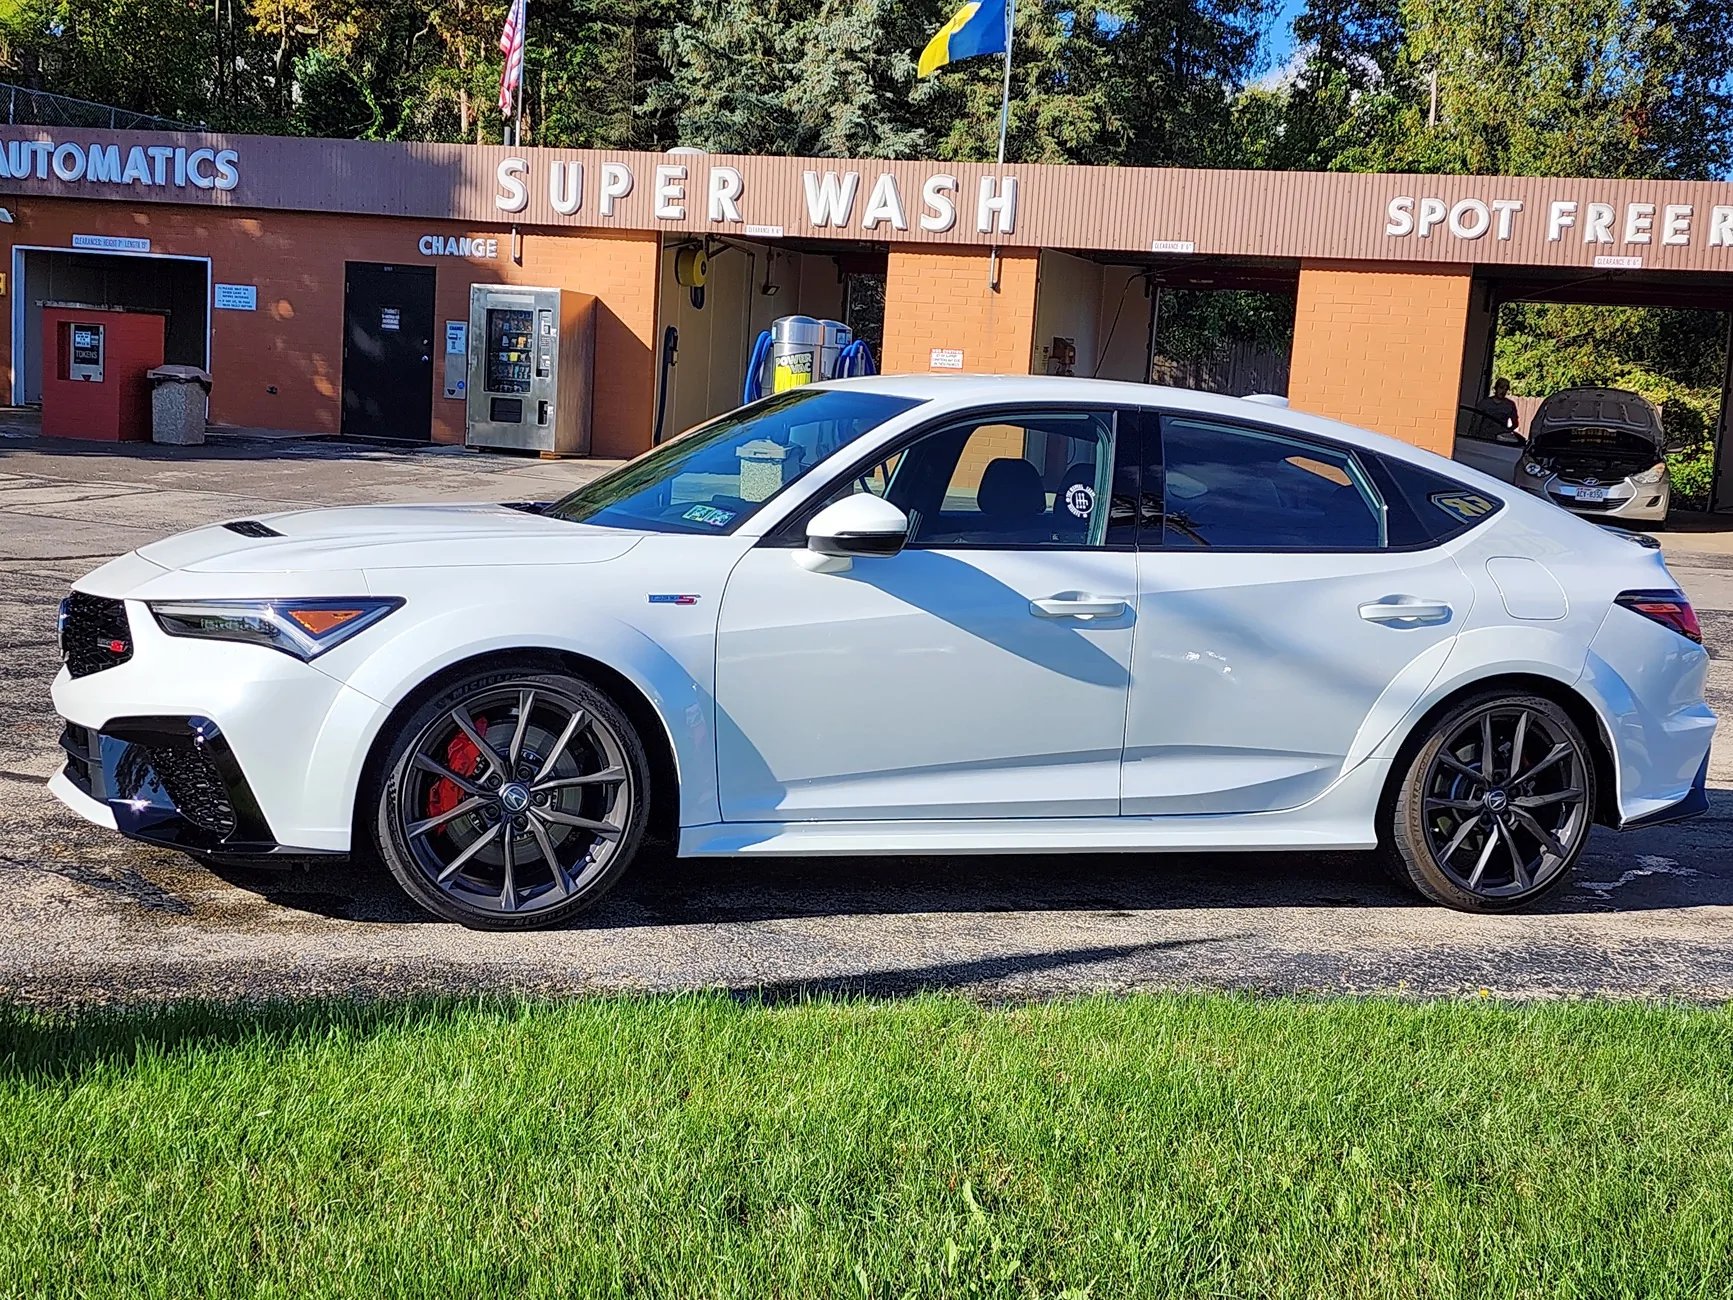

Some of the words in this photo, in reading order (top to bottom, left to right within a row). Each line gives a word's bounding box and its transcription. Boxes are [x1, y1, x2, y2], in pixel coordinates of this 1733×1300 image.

[495, 158, 744, 223] SUPER
[803, 170, 1018, 234] WASH
[1386, 196, 1523, 241] SPOT
[1548, 201, 1694, 247] FREE
[418, 235, 498, 258] CHANGE
[75, 350, 98, 360] TOKENS
[775, 352, 812, 367] POWER
[791, 362, 811, 374] VAC
